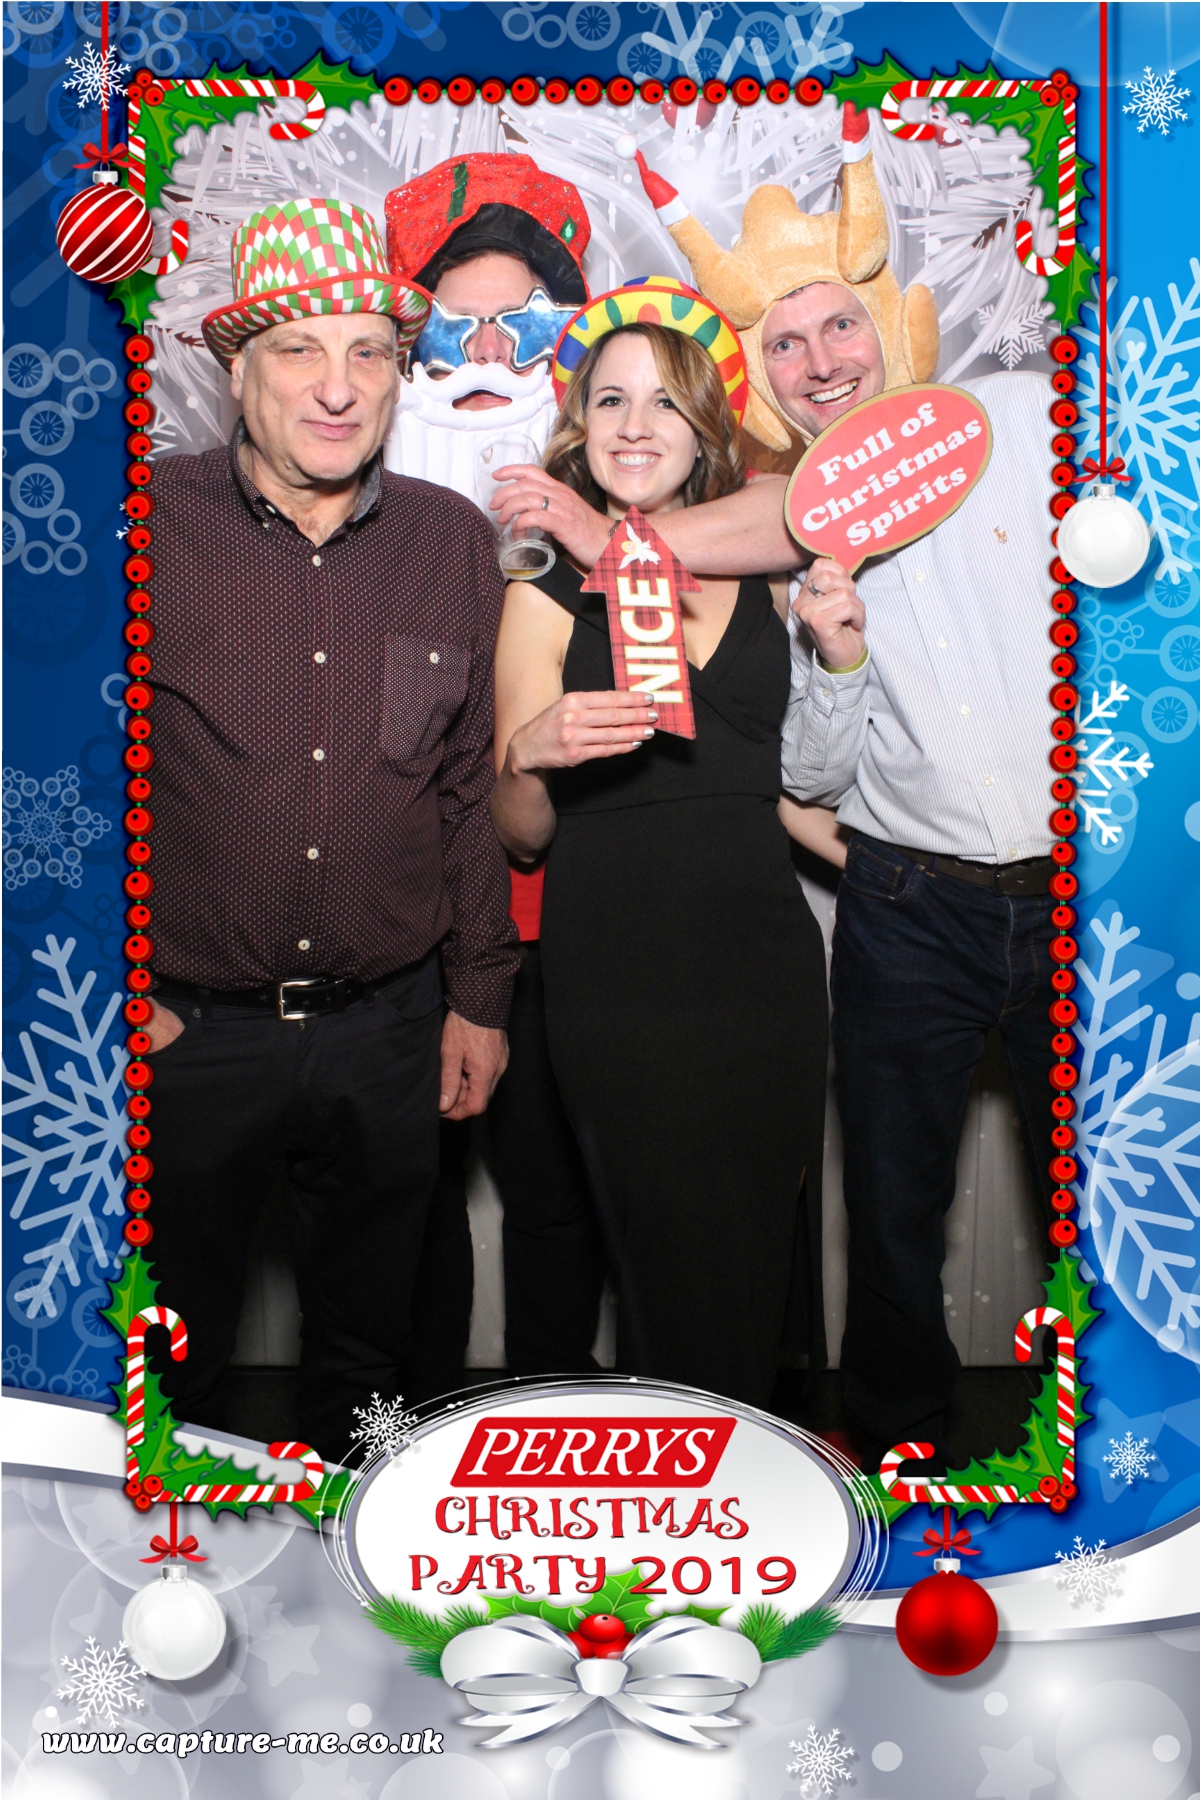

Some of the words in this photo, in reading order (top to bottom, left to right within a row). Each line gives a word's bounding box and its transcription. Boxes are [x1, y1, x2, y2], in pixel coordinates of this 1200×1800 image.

[802, 419, 982, 532] Christmas
[817, 428, 895, 486] Full
[900, 402, 937, 438] of
[846, 467, 967, 546] Spirits
[616, 576, 685, 704] NICE
